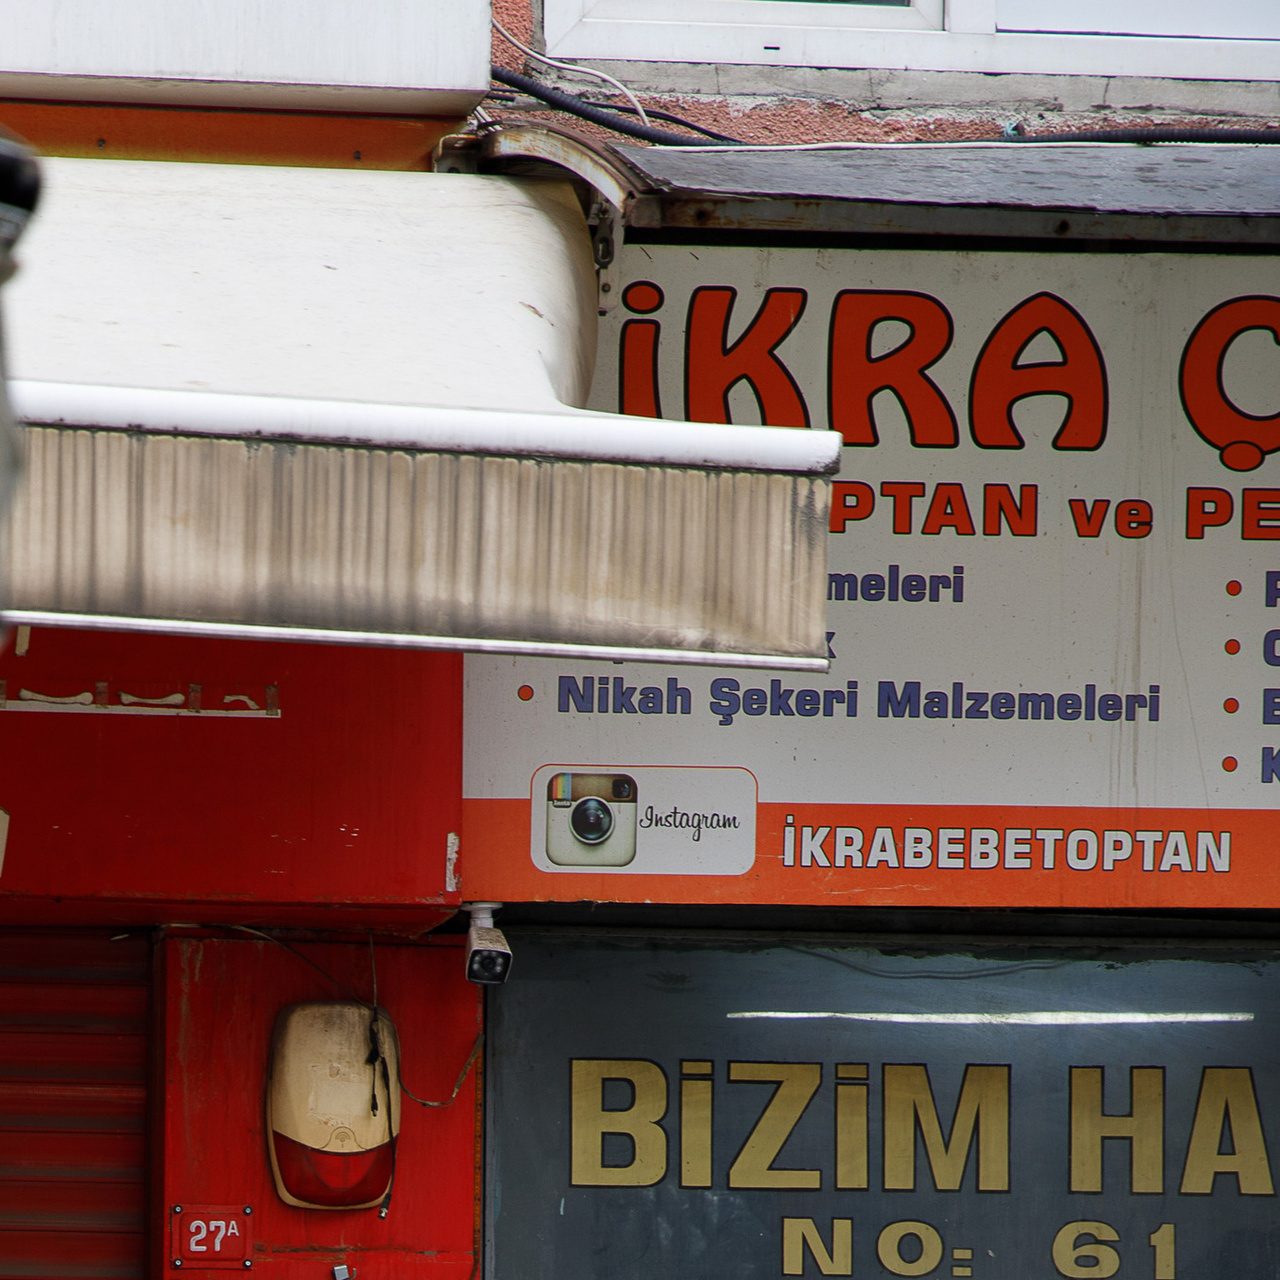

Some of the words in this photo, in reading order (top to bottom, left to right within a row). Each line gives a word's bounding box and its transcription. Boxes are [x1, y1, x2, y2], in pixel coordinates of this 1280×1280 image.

[618, 280, 1111, 452] İKRA
[1068, 498, 1154, 539] ve
[1185, 486, 1280, 541] PE
[557, 676, 692, 715] Nikah
[709, 677, 858, 726] Şekeri
[876, 680, 1161, 722] Malzemeleri
[639, 805, 741, 843] Instagram
[782, 814, 1232, 873] İKRABEBETOPTAN
[1067, 1063, 1278, 1198] HA
[189, 1219, 240, 1252] 27A
[780, 1216, 975, 1279] NO:
